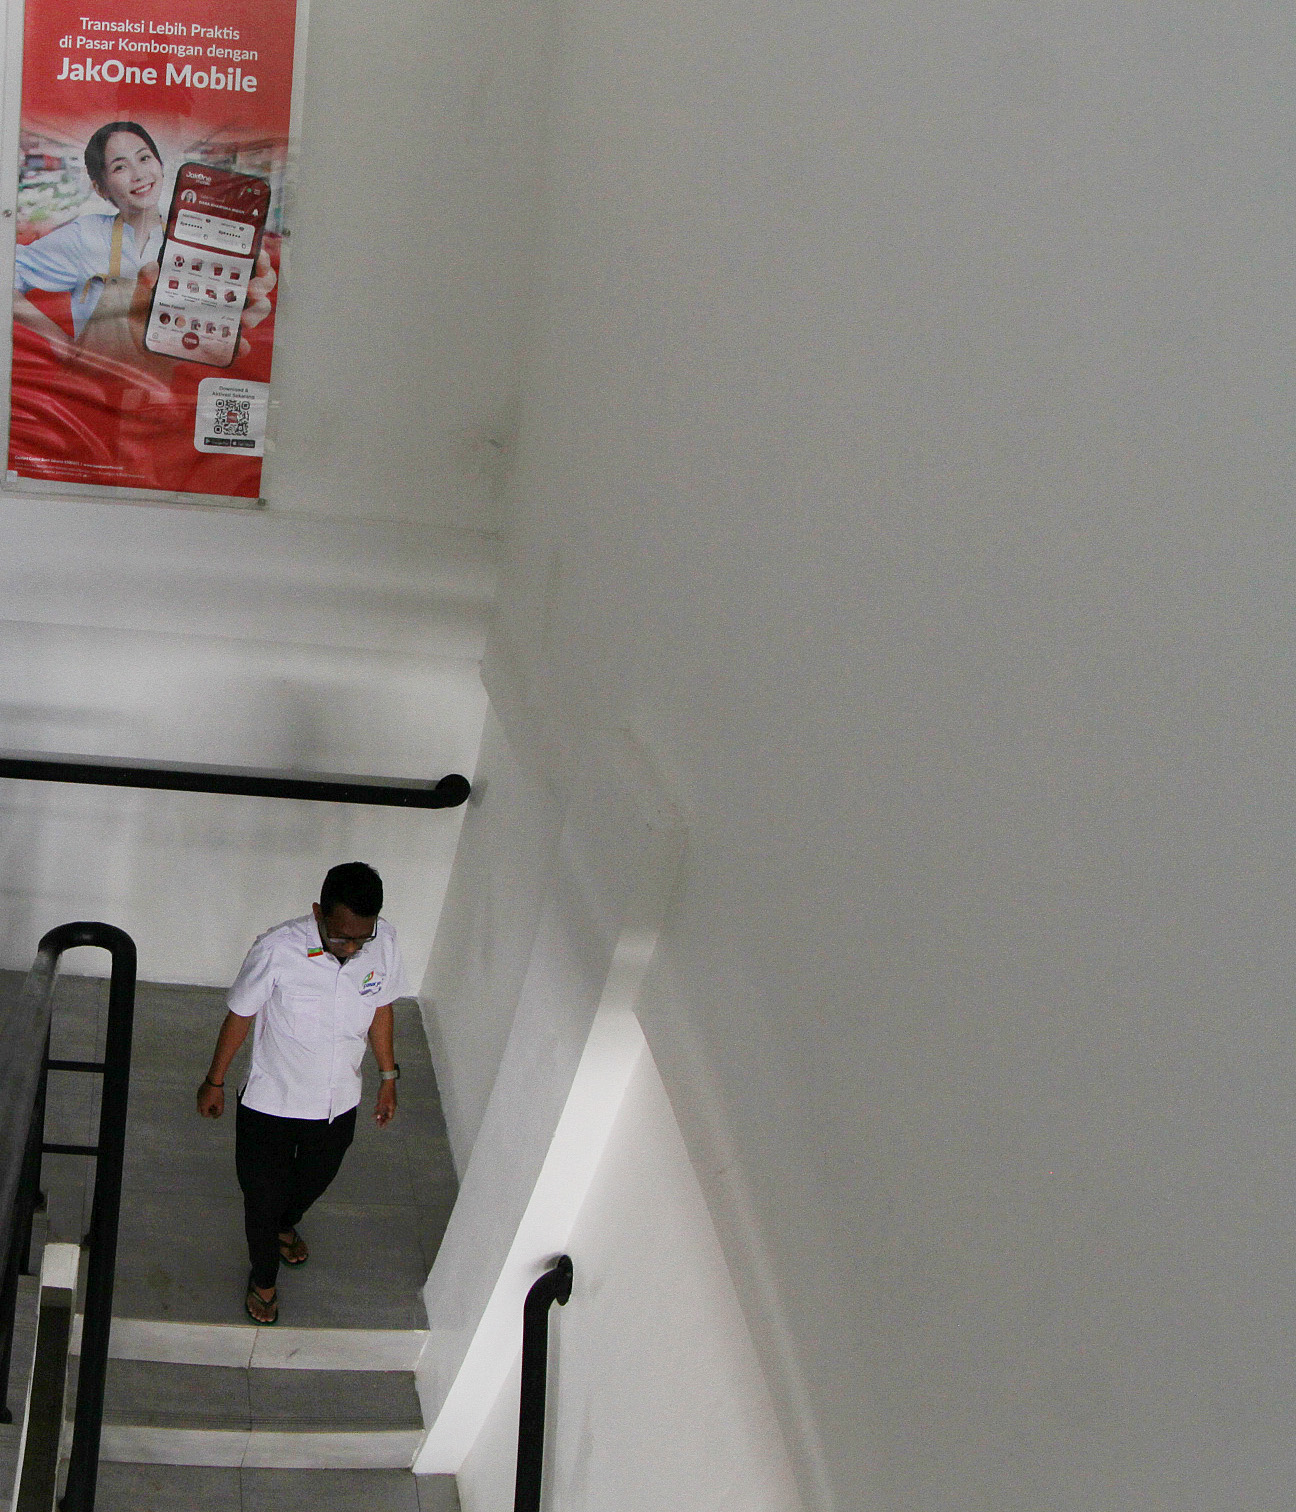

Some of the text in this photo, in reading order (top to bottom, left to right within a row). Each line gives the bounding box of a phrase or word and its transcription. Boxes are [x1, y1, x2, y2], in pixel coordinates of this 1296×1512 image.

[80, 17, 240, 40] Transaksi Lebih Praktis
[59, 35, 258, 62] di Pasar Kombongan dengan
[57, 57, 258, 92] JakOne Mobile
